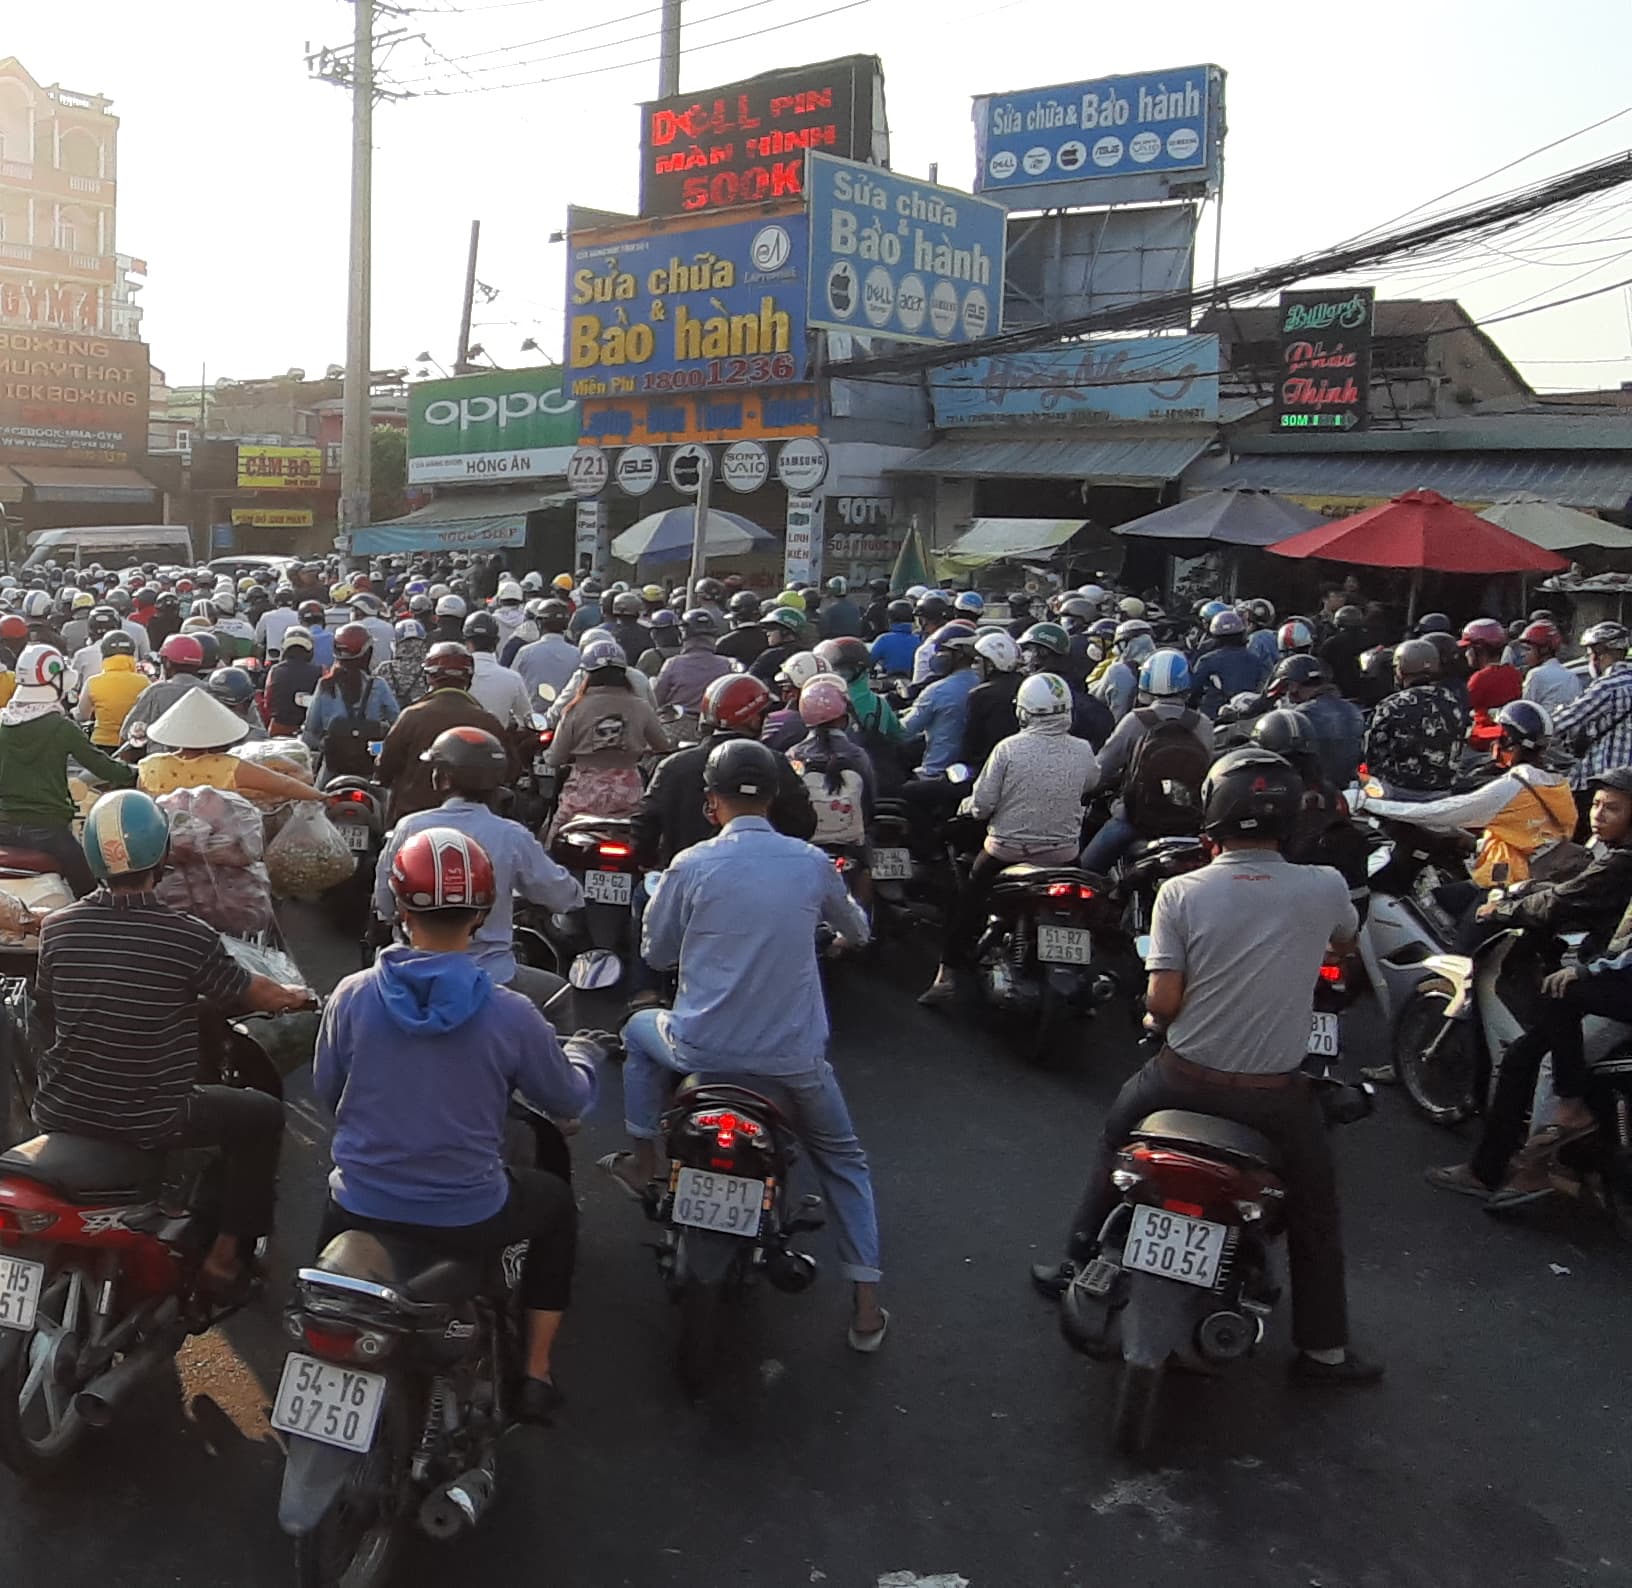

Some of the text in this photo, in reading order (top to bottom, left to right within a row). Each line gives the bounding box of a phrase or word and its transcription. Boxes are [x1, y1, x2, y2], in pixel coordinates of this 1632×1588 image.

[992, 101, 1022, 135] Sửa
[1027, 100, 1063, 129] chữa
[1080, 88, 1129, 130] Bảo
[1138, 81, 1199, 123] hành
[682, 159, 803, 210] 500K
[833, 170, 957, 228] Sửa chữa
[831, 208, 990, 286] Bảo hành
[573, 252, 735, 304] Sửa chữa
[651, 299, 665, 321] &
[570, 296, 790, 368] Bảo hành
[573, 456, 604, 476] 721
[724, 462, 766, 473] VAIO
[726, 452, 765, 461] SONY
[780, 455, 824, 466] SAMSUNG
[690, 1174, 747, 1204] 59-P1
[1145, 1212, 1210, 1251] 59-Y2
[1131, 1238, 1209, 1280] 150.54
[295, 1362, 369, 1407] 54-Y6
[287, 1396, 360, 1441] 9750
